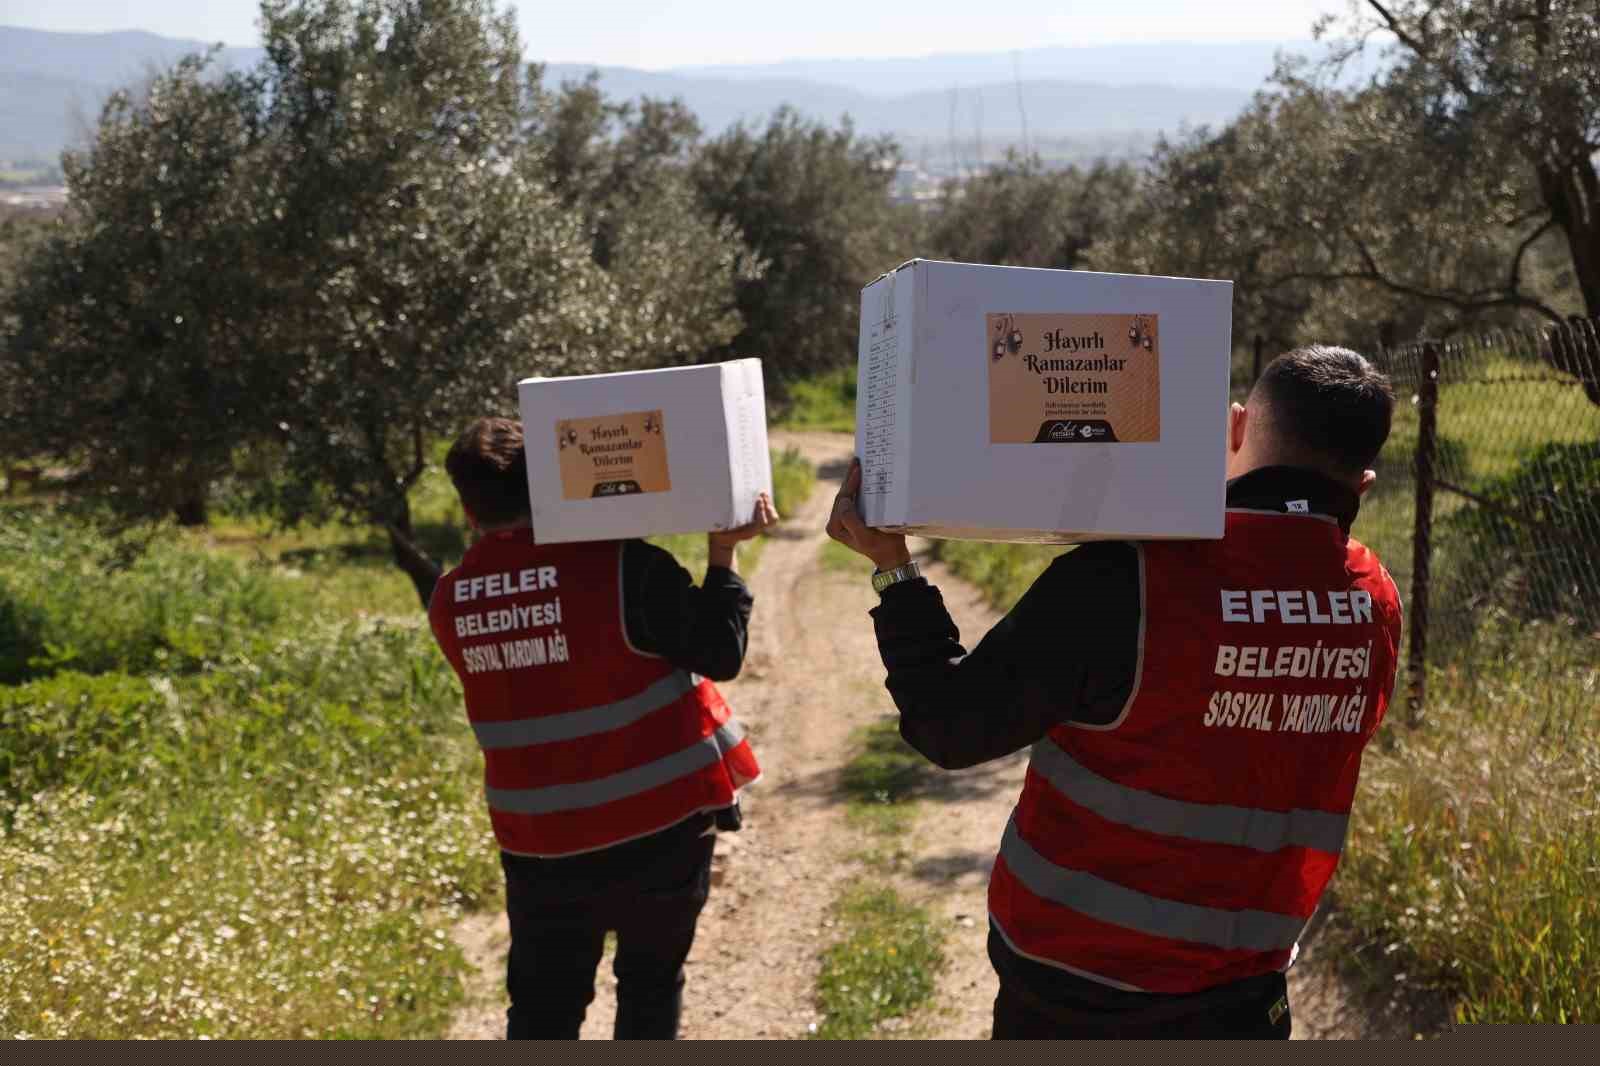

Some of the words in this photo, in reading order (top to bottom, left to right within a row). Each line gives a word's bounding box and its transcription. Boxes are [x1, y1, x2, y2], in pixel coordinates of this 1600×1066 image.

[1043, 328, 1104, 353] Hayırlı
[1023, 354, 1127, 374] Ramazanlar
[1043, 376, 1108, 394] Dilerim
[580, 439, 643, 456] Ramazanlar
[592, 424, 629, 441] Hayırlı
[592, 455, 633, 467] Dilerim
[454, 566, 559, 603] EFELER
[454, 596, 562, 638] BELEDİYESİ
[1220, 589, 1374, 624] EFELER
[462, 643, 503, 674] SOSYAL
[500, 637, 547, 670] YARDIM
[547, 628, 570, 663] AĞI
[1214, 639, 1373, 679] BELEDİYESİ
[1203, 690, 1275, 731] SOSYAL
[1331, 685, 1367, 733] AĞI
